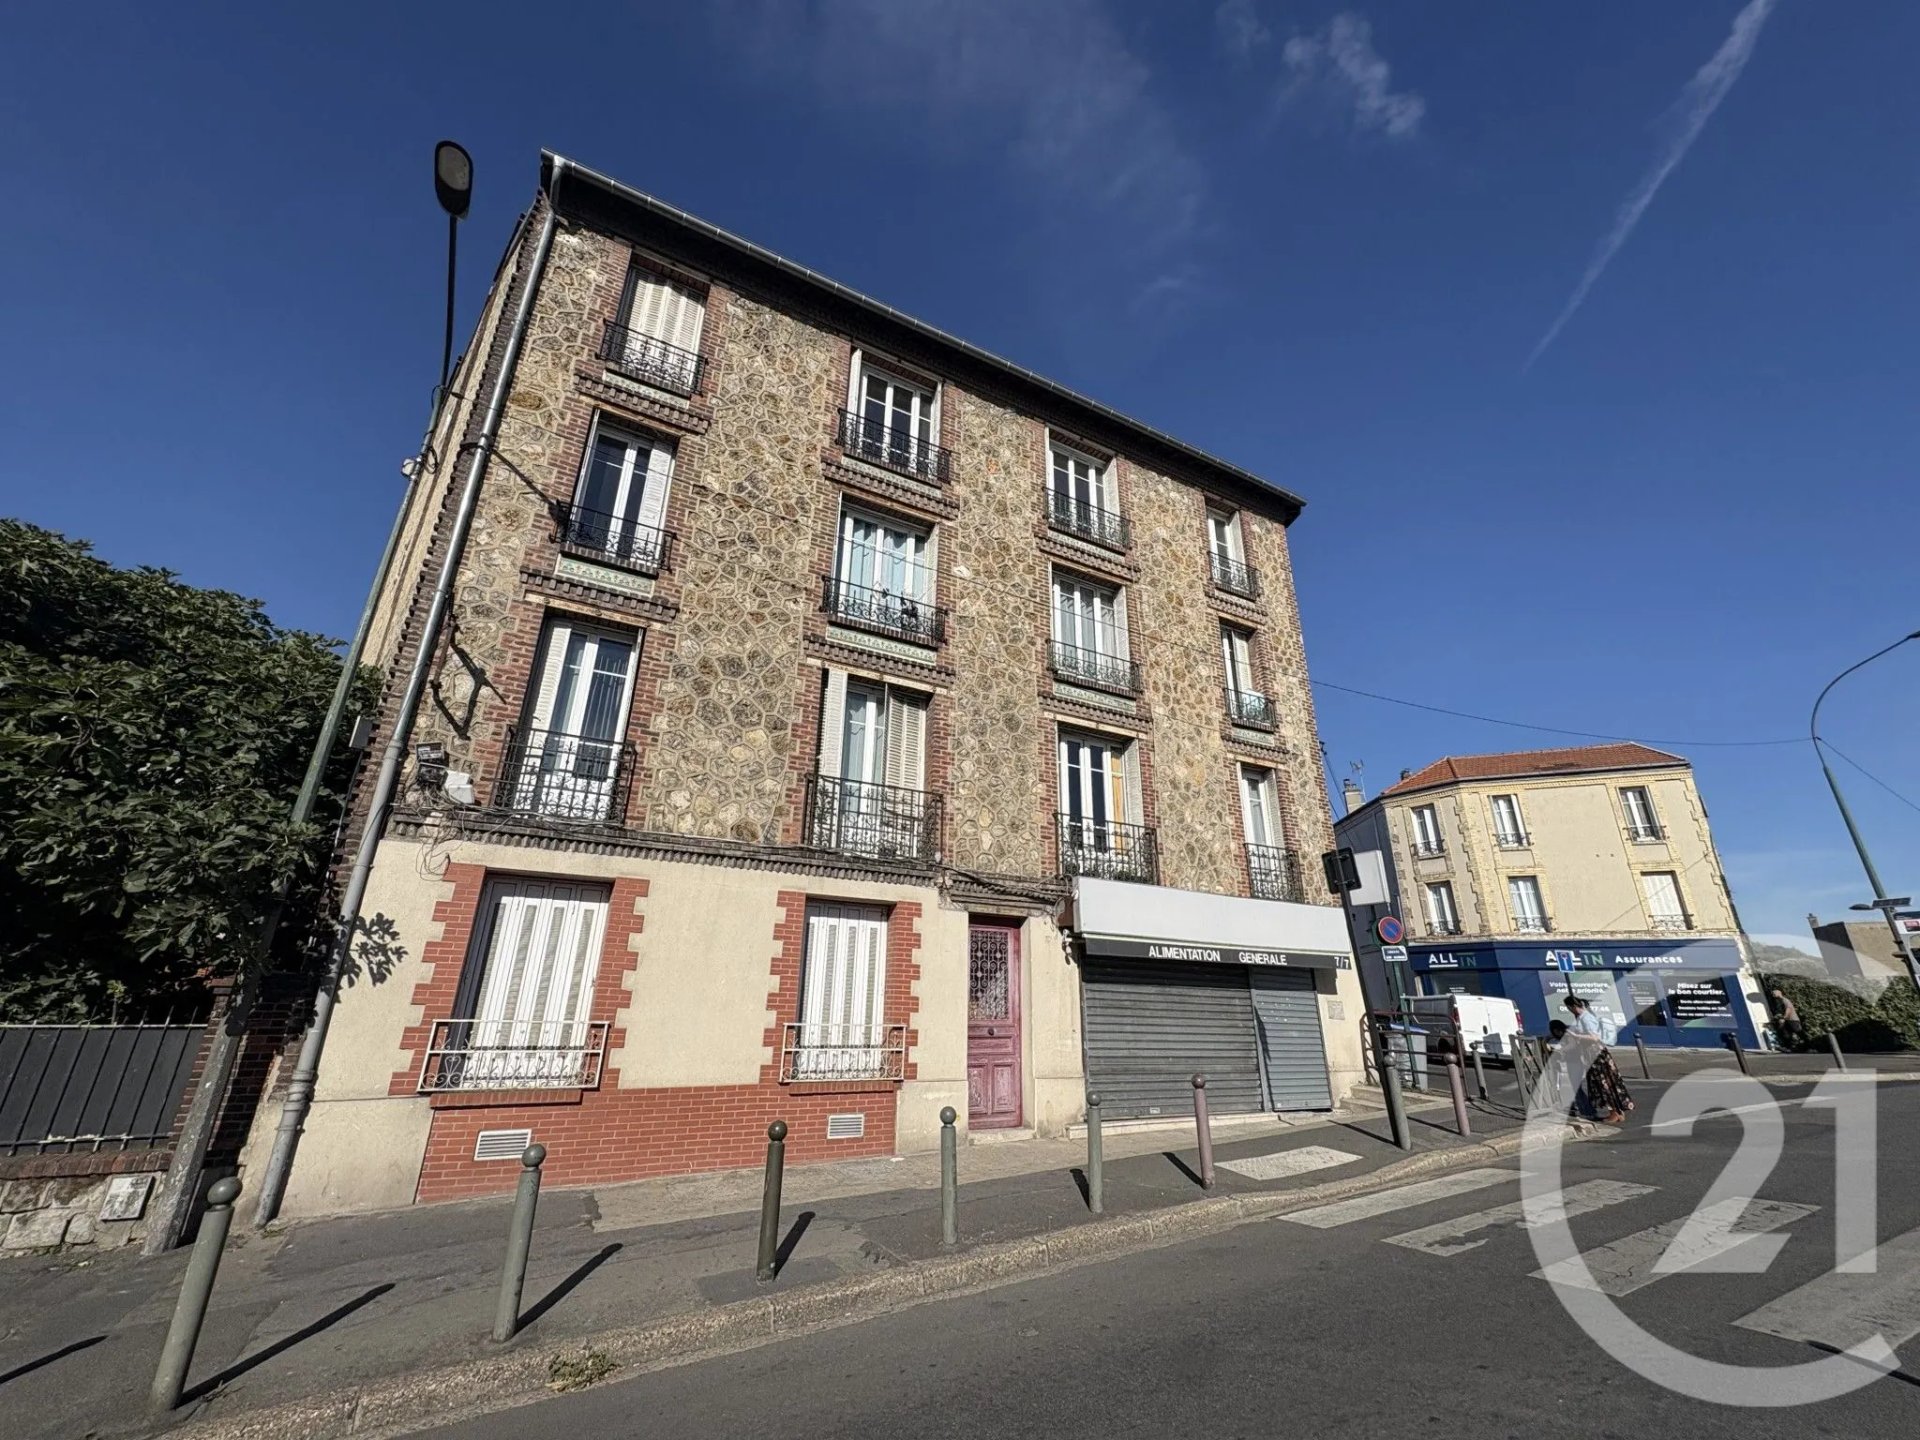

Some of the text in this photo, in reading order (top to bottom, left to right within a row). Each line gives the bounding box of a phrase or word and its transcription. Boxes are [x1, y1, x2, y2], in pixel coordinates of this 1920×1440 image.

[1148, 945, 1288, 966] ALIMENTATION GENERALE
[1333, 956, 1350, 969] 7/7
[1428, 952, 1477, 967] ALL IN
[1545, 950, 1684, 965] AL IN Assurances
